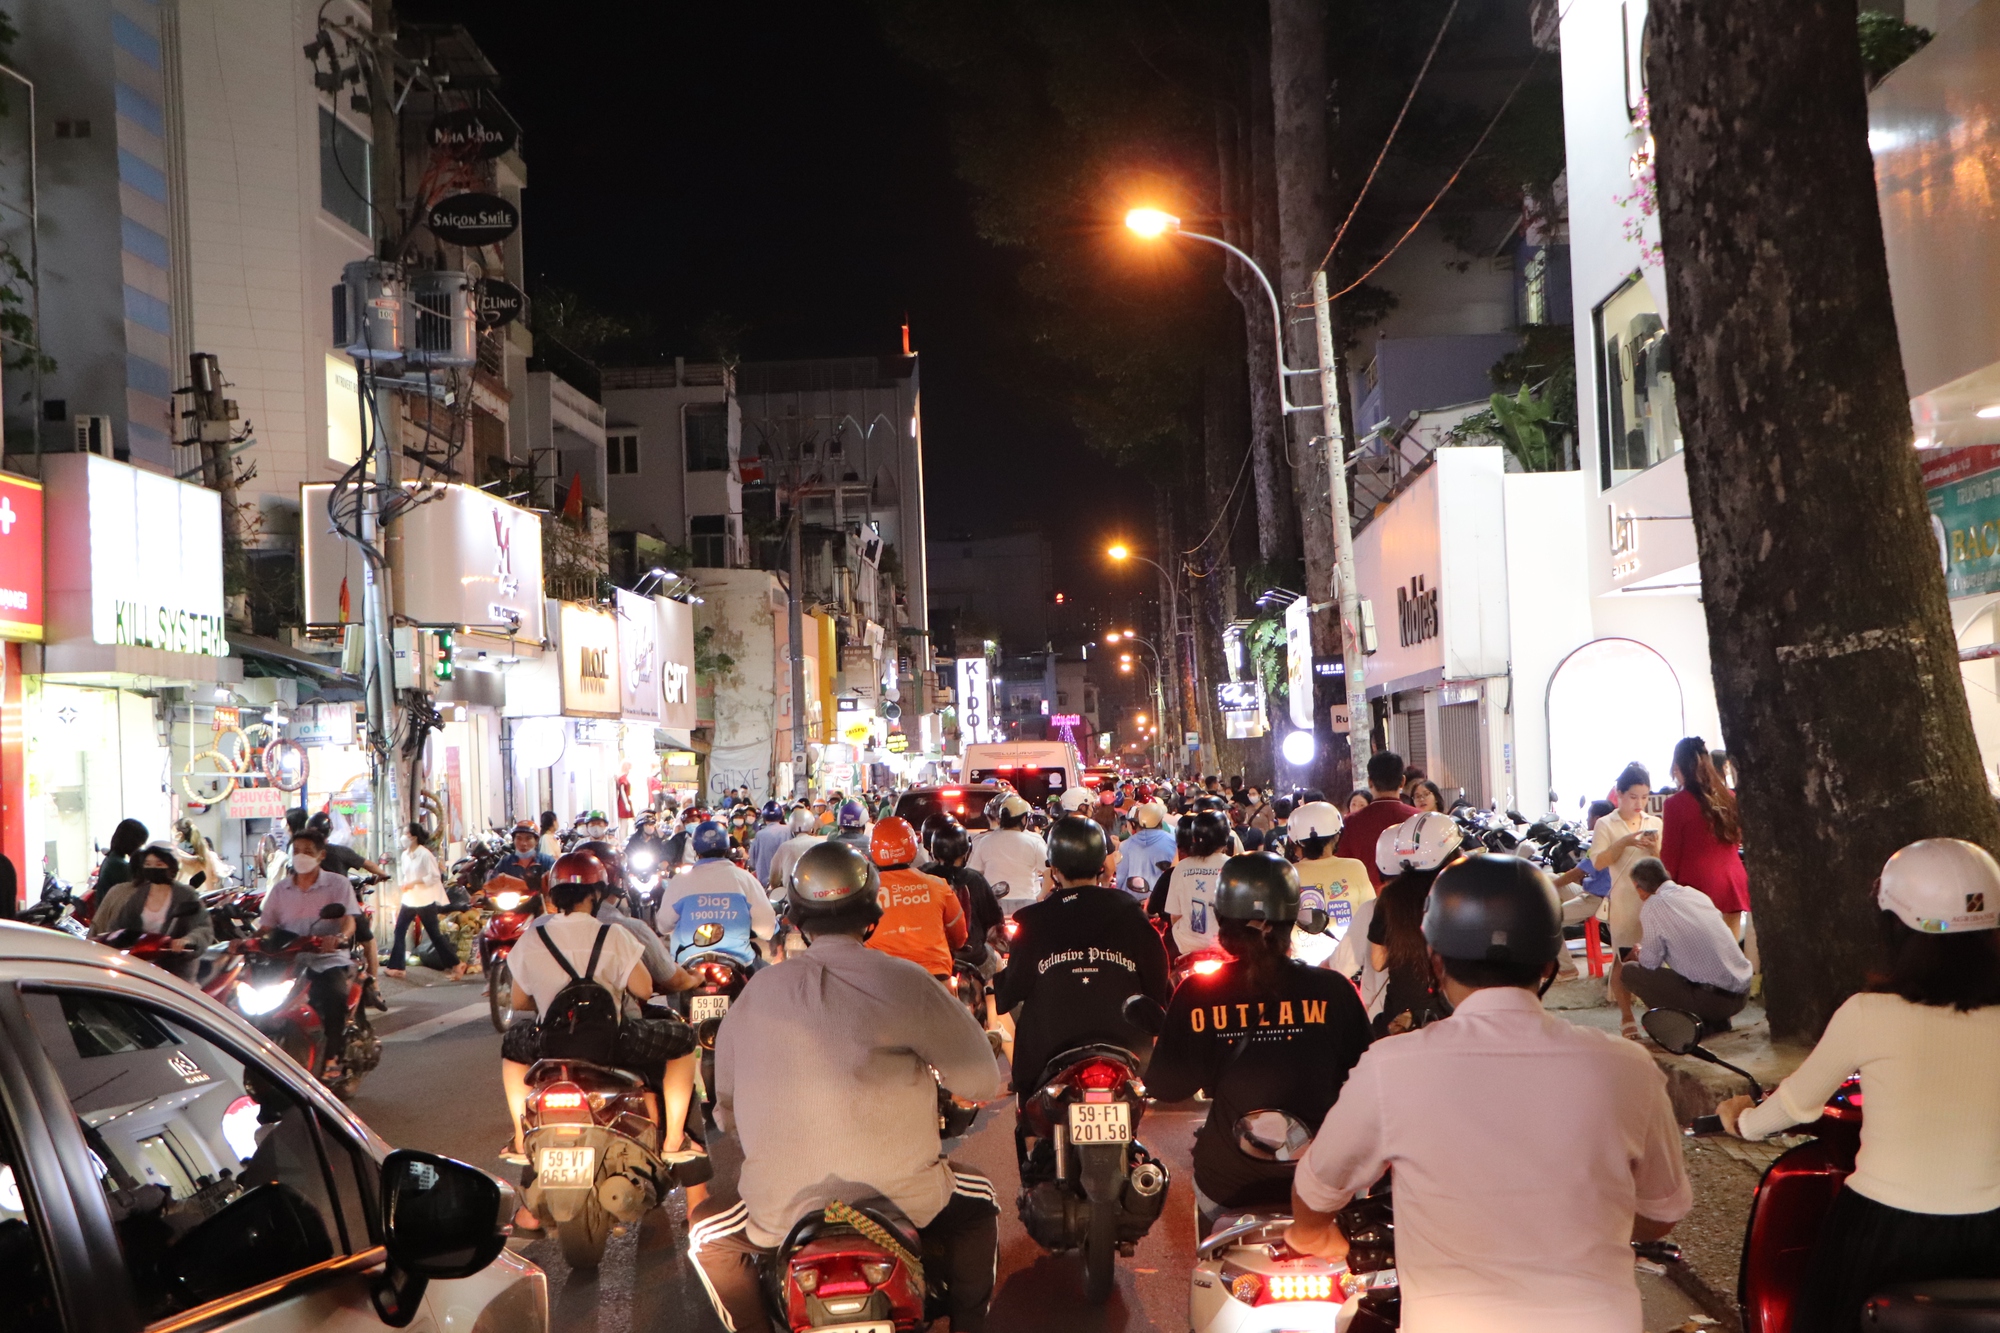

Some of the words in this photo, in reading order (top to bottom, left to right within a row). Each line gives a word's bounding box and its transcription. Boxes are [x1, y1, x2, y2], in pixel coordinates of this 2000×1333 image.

[1951, 517, 2000, 567] BẠC
[1397, 574, 1438, 647] Rubies
[116, 599, 153, 647] KILL
[158, 605, 221, 657] SYSTEM
[662, 661, 688, 704] GPT
[965, 661, 980, 727] KIDO
[231, 789, 282, 803] CHUYÊN
[813, 887, 850, 898] TOPCOM
[891, 883, 928, 893] Shopee
[893, 893, 931, 906] Food
[690, 910, 738, 921] 19001717
[1038, 948, 1084, 974] Exclusive
[1088, 947, 1136, 972] Privilege
[697, 998, 724, 1008] 59-D2
[1191, 1000, 1327, 1032] OUTLAW
[1078, 1106, 1119, 1122] 59-F1
[1074, 1124, 1127, 1141] 201.58
[548, 1151, 584, 1167] 59-V1
